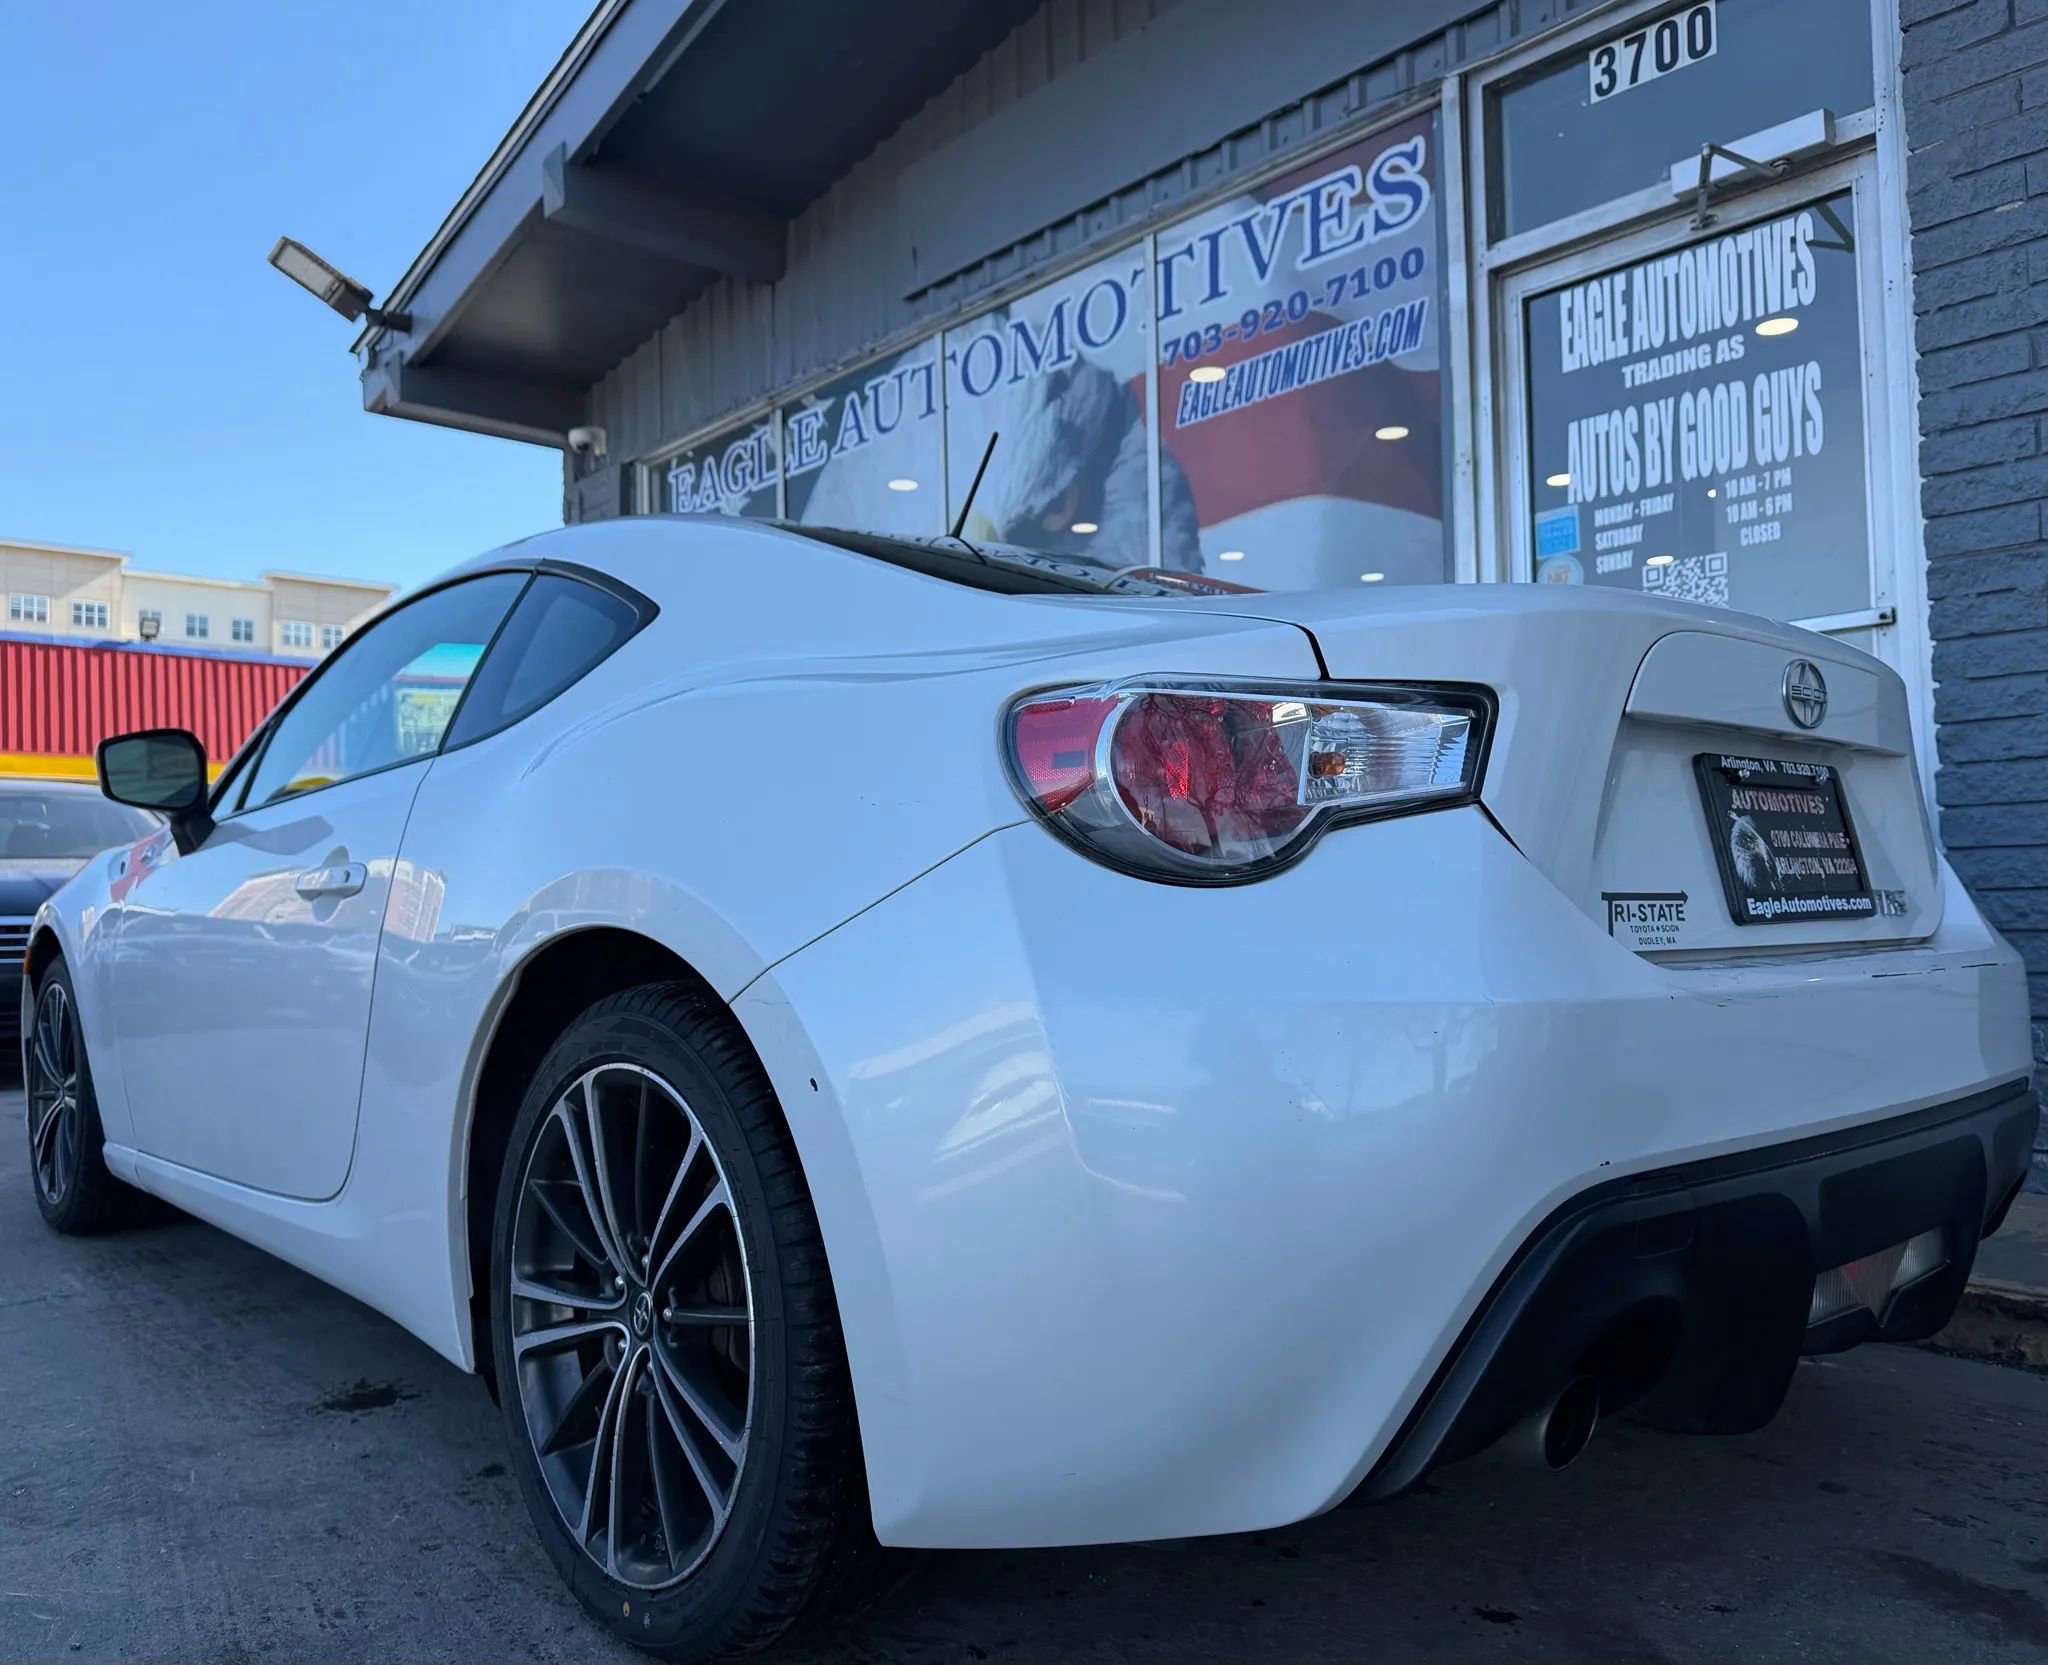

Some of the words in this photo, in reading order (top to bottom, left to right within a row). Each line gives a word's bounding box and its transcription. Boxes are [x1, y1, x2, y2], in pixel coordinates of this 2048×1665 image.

[1594, 5, 1712, 97] 3700
[1163, 247, 1425, 367] 703-920-7100
[1559, 272, 1629, 374] EAGLE
[1631, 211, 1816, 353] AUTOMOTIVES
[668, 407, 828, 512] EAGLE
[832, 136, 1430, 456] AUTOMOTIVES
[1175, 298, 1429, 428] EAGLEAUTOMOTIVES.COM
[1621, 343, 1712, 388] TRADING
[1715, 334, 1745, 364] AS
[1568, 405, 1641, 504] AUTOS
[1644, 396, 1675, 489] BY
[1679, 380, 1748, 481] GOOD
[1753, 361, 1824, 466] GUYS
[1725, 479, 1738, 499] 10
[1739, 474, 1757, 496] AM
[1763, 471, 1770, 490] 7
[1774, 467, 1792, 488] PM
[1725, 504, 1739, 523] 10
[1740, 500, 1758, 521] AM
[1775, 492, 1792, 514] PM
[1741, 521, 1781, 546] CLOSED
[1721, 755, 1763, 773] Arlington,
[1763, 760, 1777, 773] VA
[1731, 789, 1825, 815] AUTOMOTIVES
[1747, 895, 1872, 918] EagleAutomotives.com
[1630, 925, 1655, 933] TOYOTA
